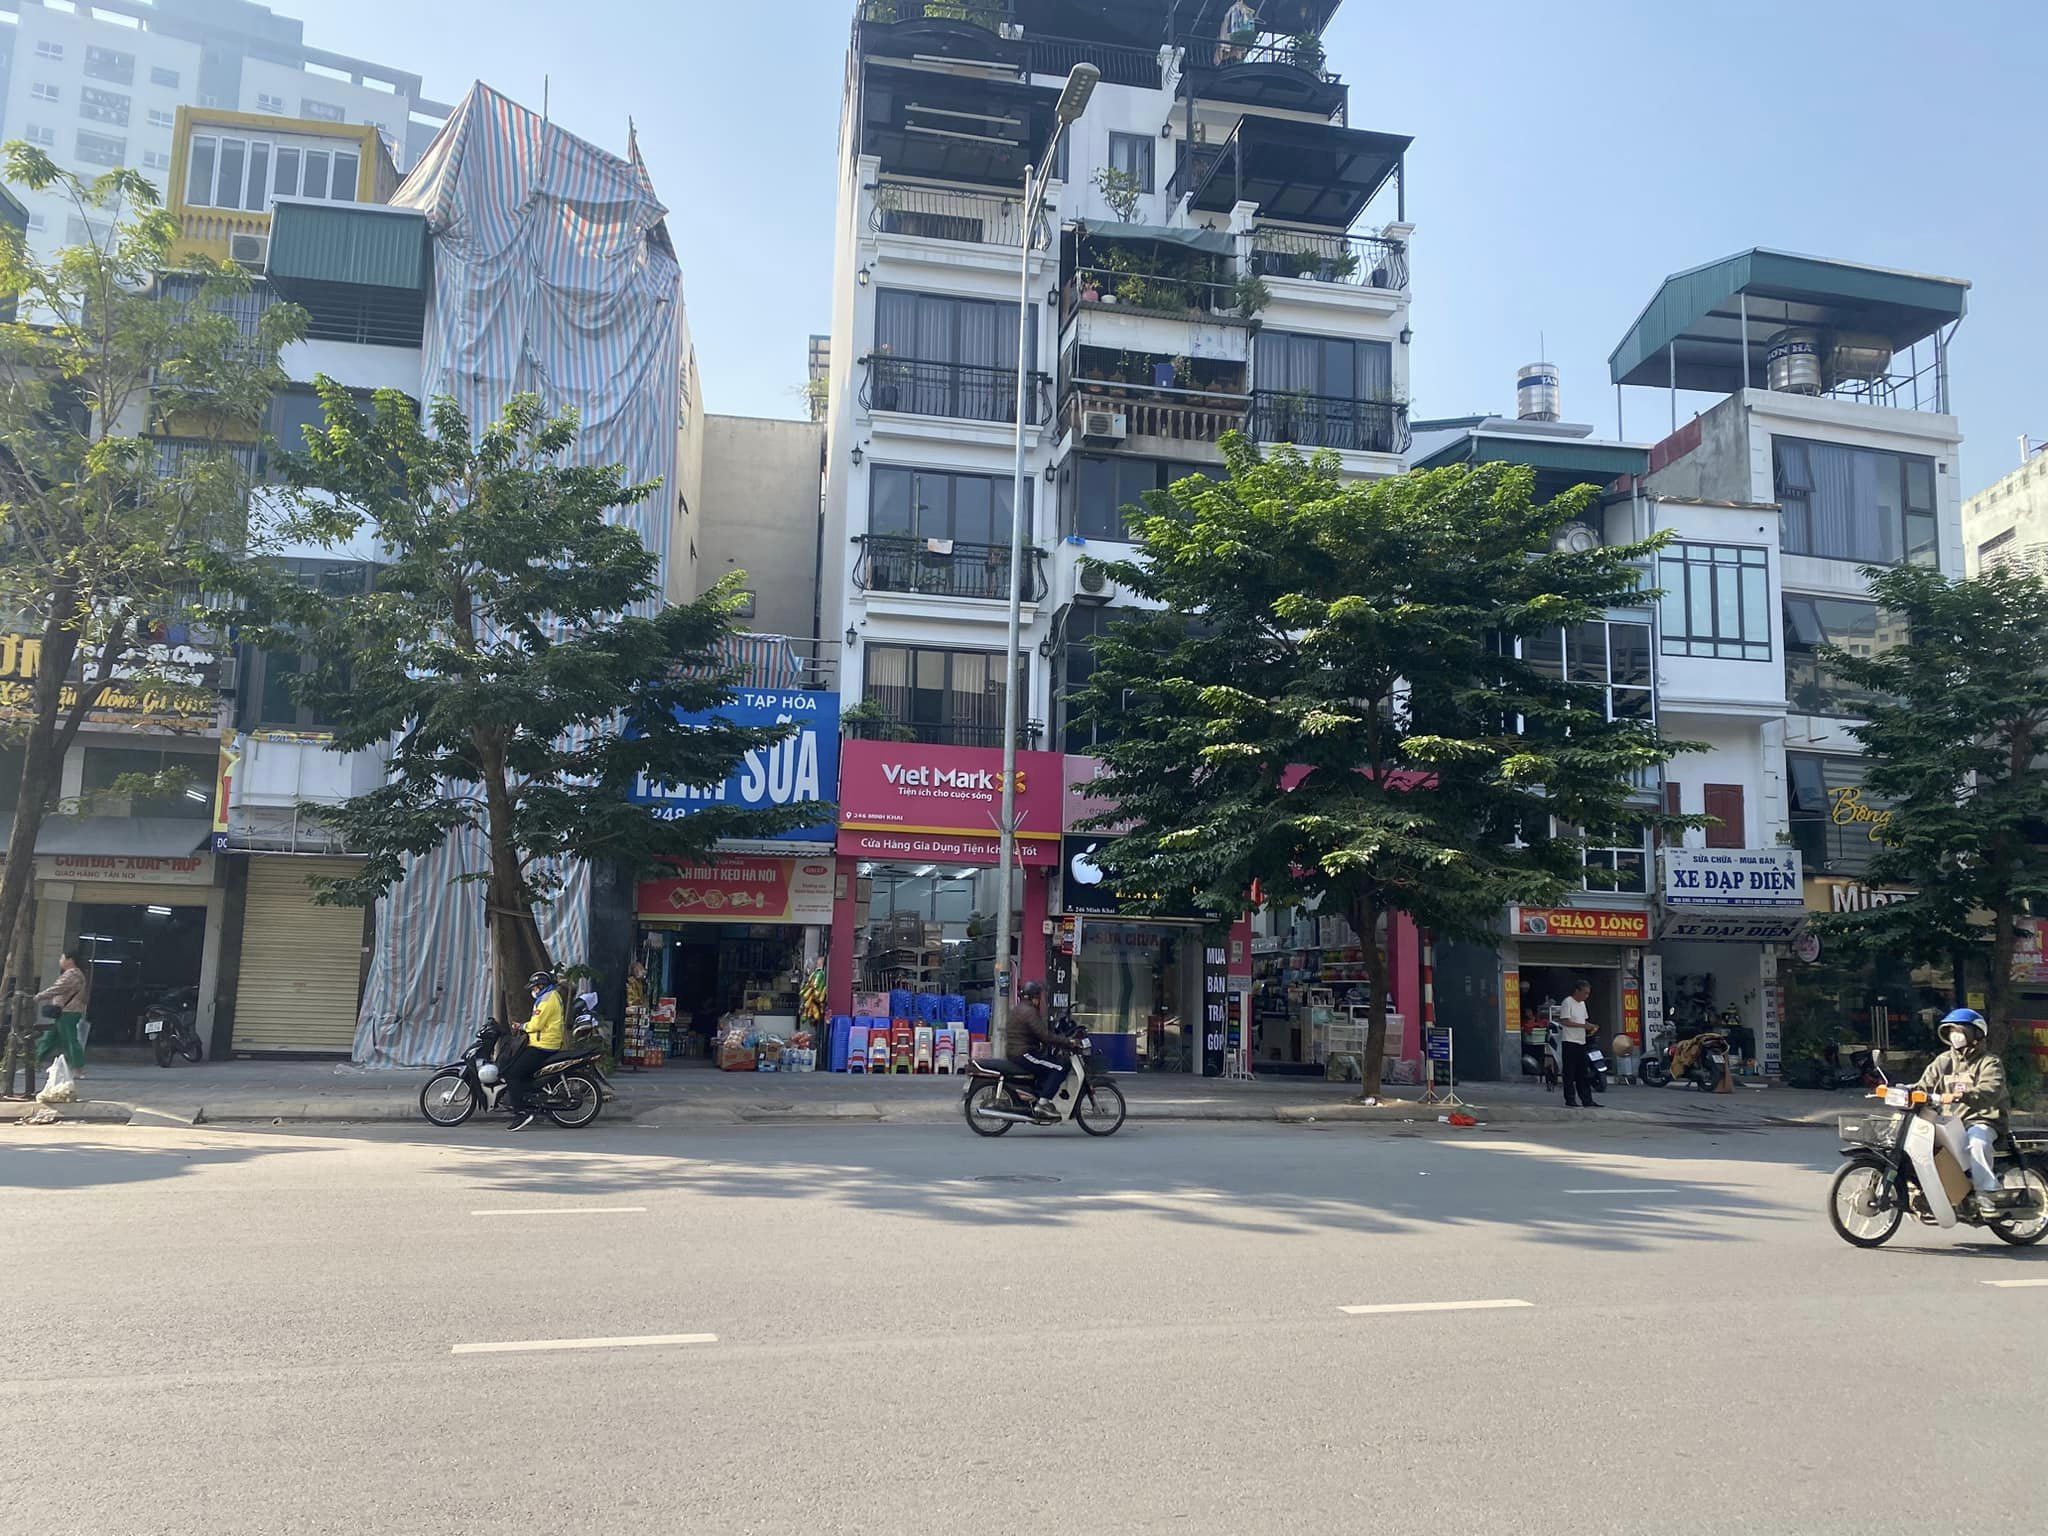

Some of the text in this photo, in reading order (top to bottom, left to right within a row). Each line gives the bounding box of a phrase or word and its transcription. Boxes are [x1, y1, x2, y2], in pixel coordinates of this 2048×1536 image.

[744, 694, 776, 710] TẠP
[782, 694, 816, 710] HÓA
[740, 713, 820, 804] SỮA
[934, 767, 993, 790] Mark
[899, 786, 993, 802] Tiện ích cho cuộc sống
[861, 837, 881, 848] Cửa
[883, 839, 911, 851] Hàng
[913, 840, 930, 850] Gia
[932, 842, 960, 854] Dụng
[962, 843, 984, 854] Tiện
[1022, 845, 1038, 856] Tốt
[1693, 854, 1709, 863] SỬA
[1711, 854, 1732, 864] CHỮA
[1740, 856, 1757, 865] MUA
[1759, 855, 1776, 865] BÁN
[758, 868, 776, 883] NỘI
[1673, 867, 1796, 895] XE ĐẠP ĐIỆN
[1549, 911, 1596, 929] CHÁO
[1600, 913, 1645, 930] LÒNG
[1672, 925, 1701, 935] XE
[1206, 948, 1226, 965] MUA
[1207, 973, 1225, 993] BÁN
[1208, 1000, 1225, 1021] TRẢ
[1207, 1030, 1225, 1050] GÓP
